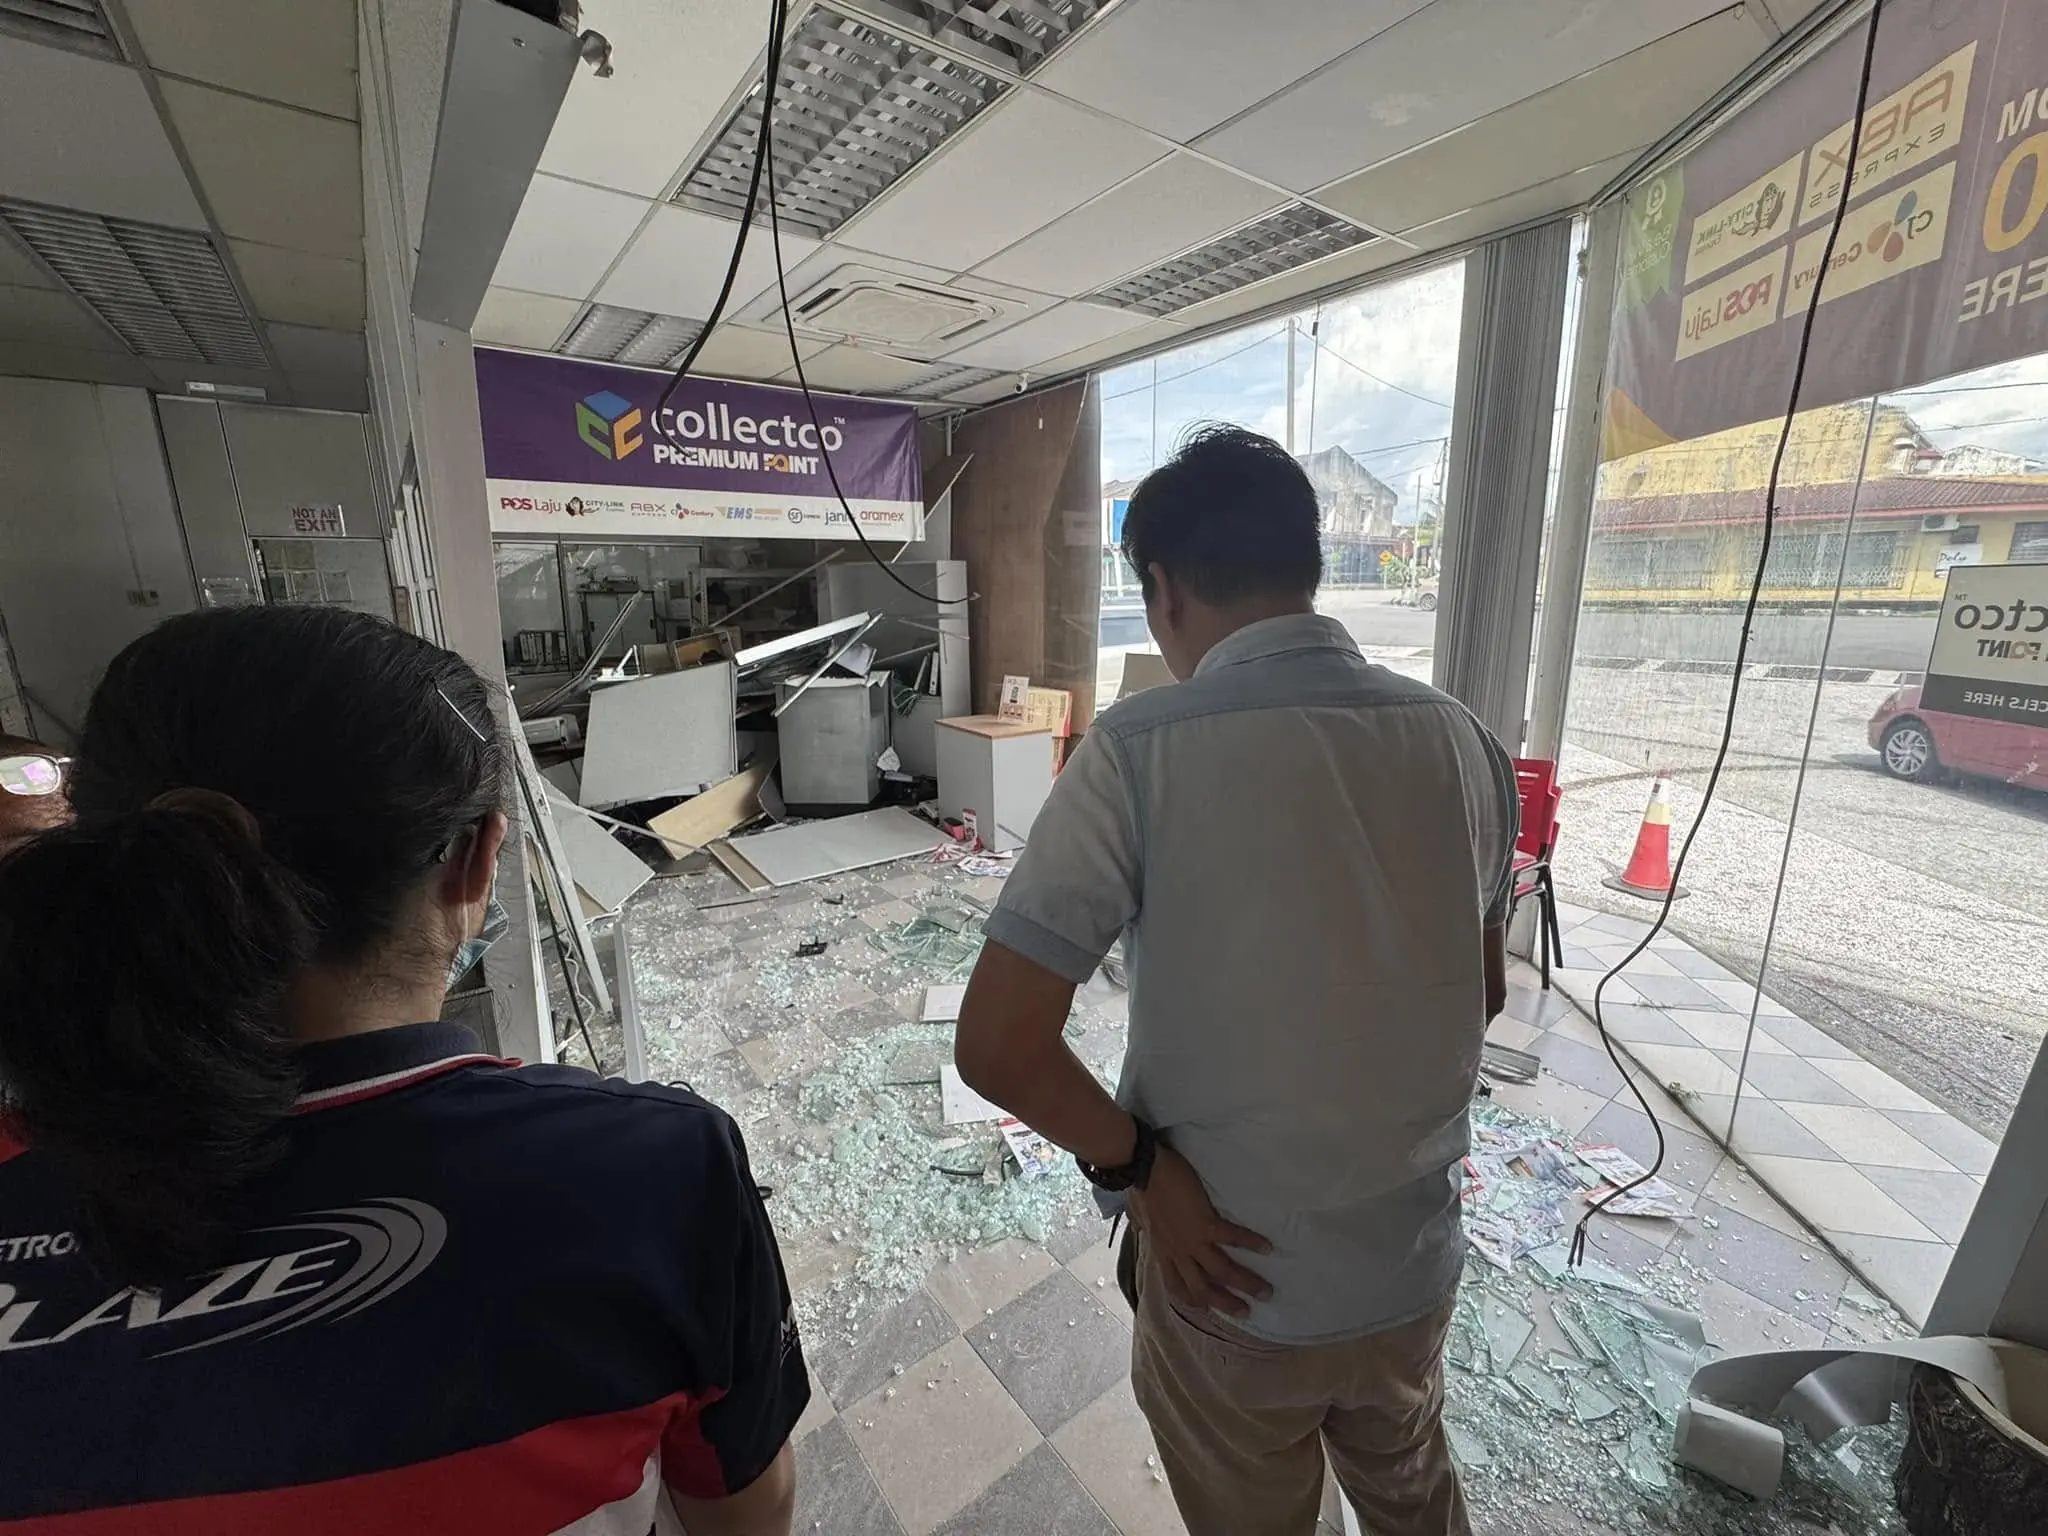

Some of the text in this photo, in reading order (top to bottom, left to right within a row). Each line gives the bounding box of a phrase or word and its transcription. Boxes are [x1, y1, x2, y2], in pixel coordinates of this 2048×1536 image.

[651, 402, 843, 451] collectco
[653, 444, 819, 475] PREMIUM POINT
[500, 497, 561, 514] POS Laju
[631, 502, 666, 512] ABX
[291, 507, 316, 519] NOT
[726, 507, 753, 520] EMS
[859, 510, 904, 522] aramex
[294, 519, 337, 532] EXIT
